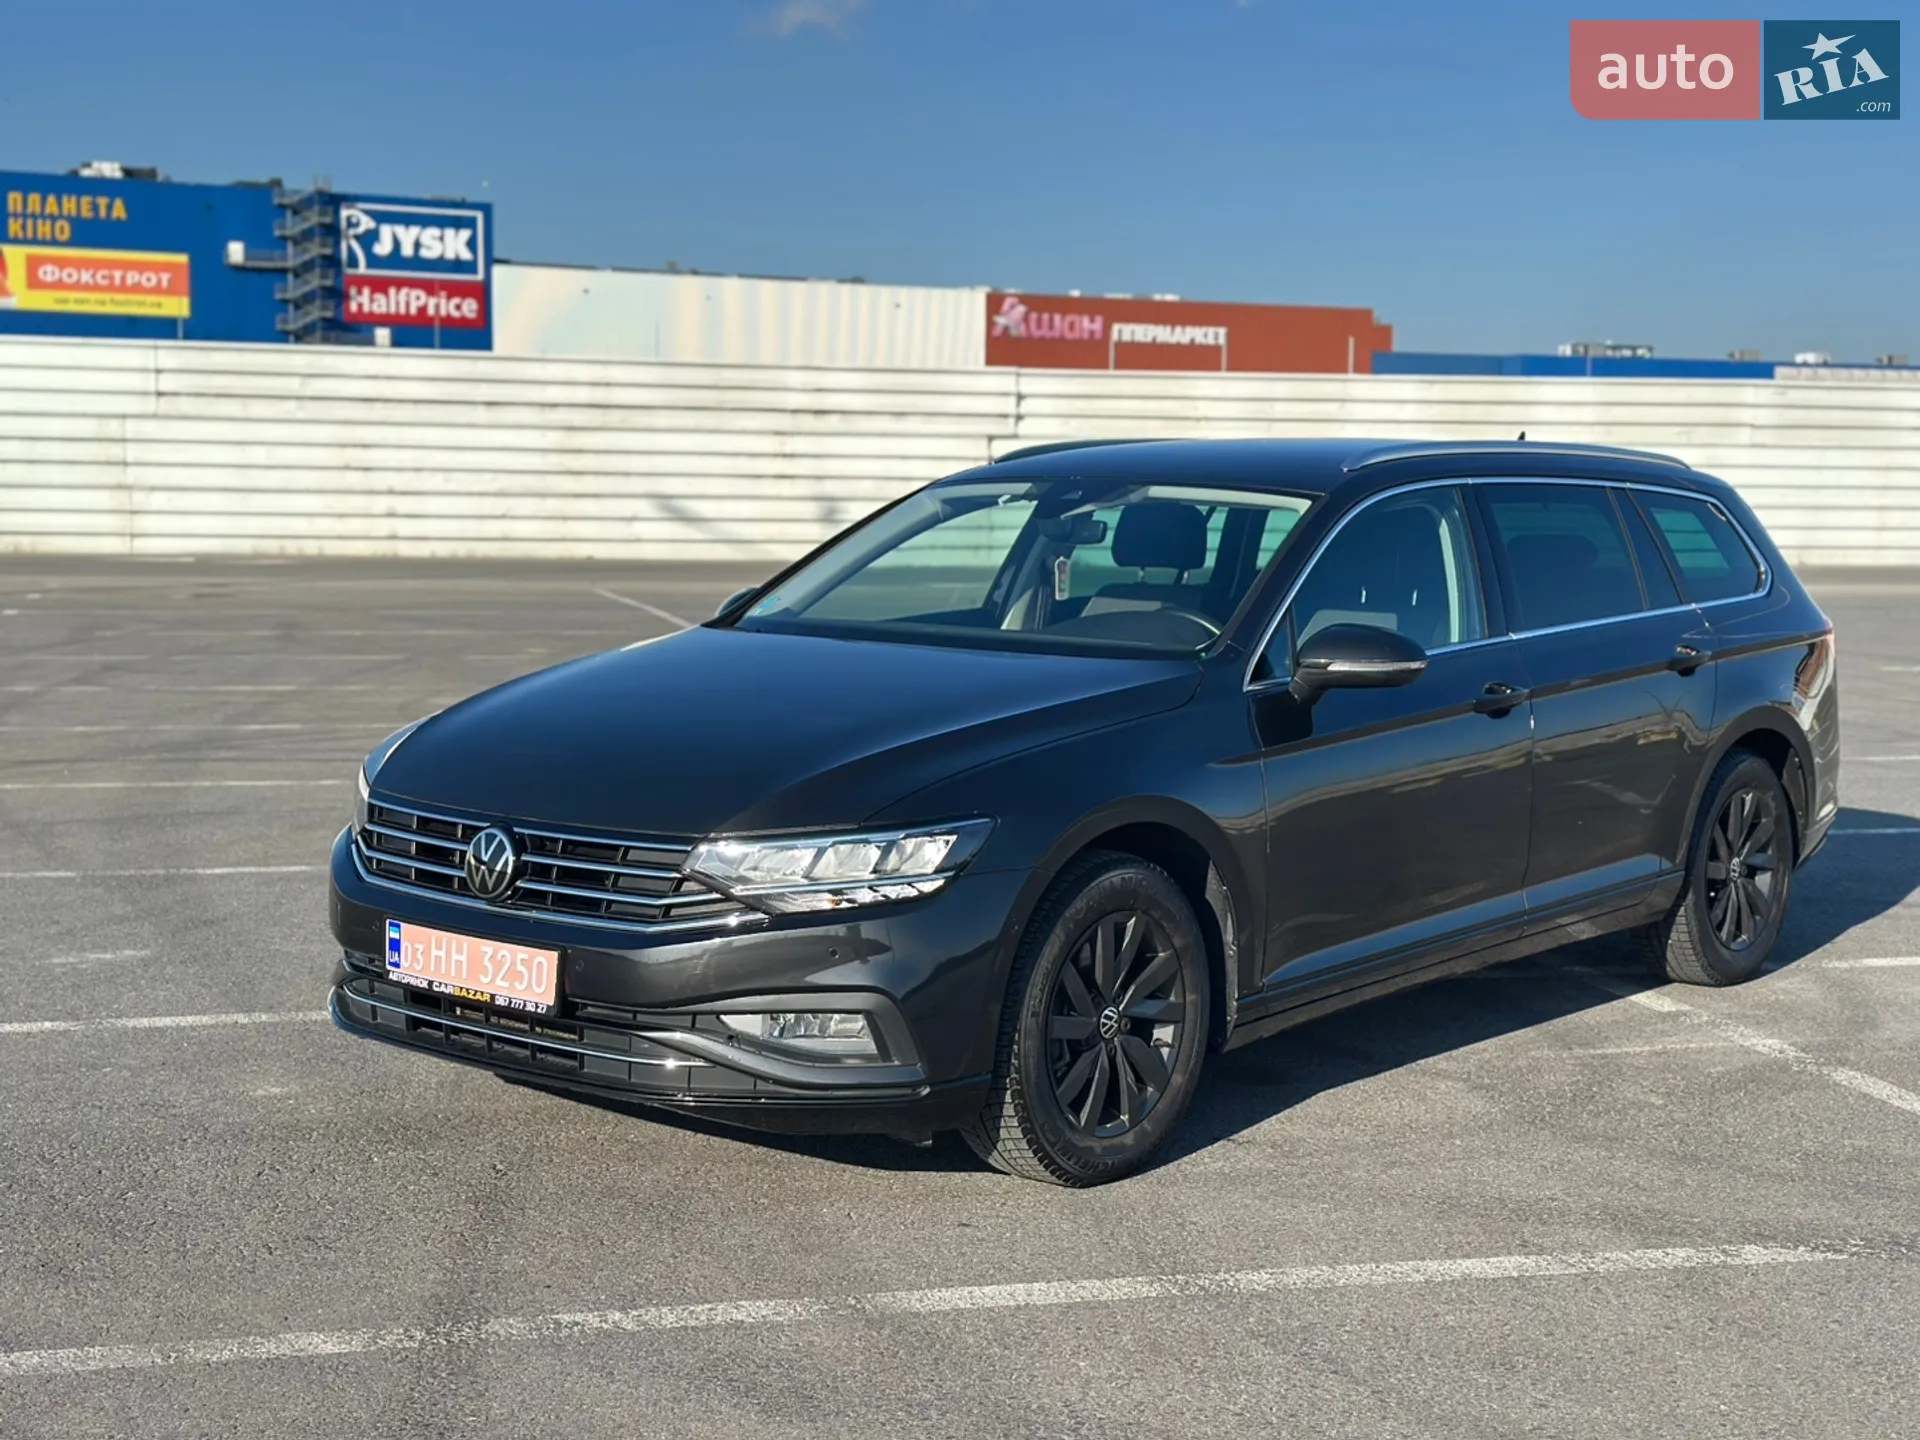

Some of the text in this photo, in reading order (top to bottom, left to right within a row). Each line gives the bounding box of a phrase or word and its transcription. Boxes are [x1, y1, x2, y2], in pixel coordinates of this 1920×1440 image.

[7, 190, 128, 221] ПЛАНЕТА
[7, 215, 72, 242] КІНО
[372, 223, 475, 262] JYSK
[37, 263, 172, 290] ФОКСТРОТ
[348, 286, 479, 320] HalfPrice
[389, 950, 400, 963] UA
[402, 935, 549, 995] 03 HH 3250
[432, 982, 491, 1002] CARBAZAR
